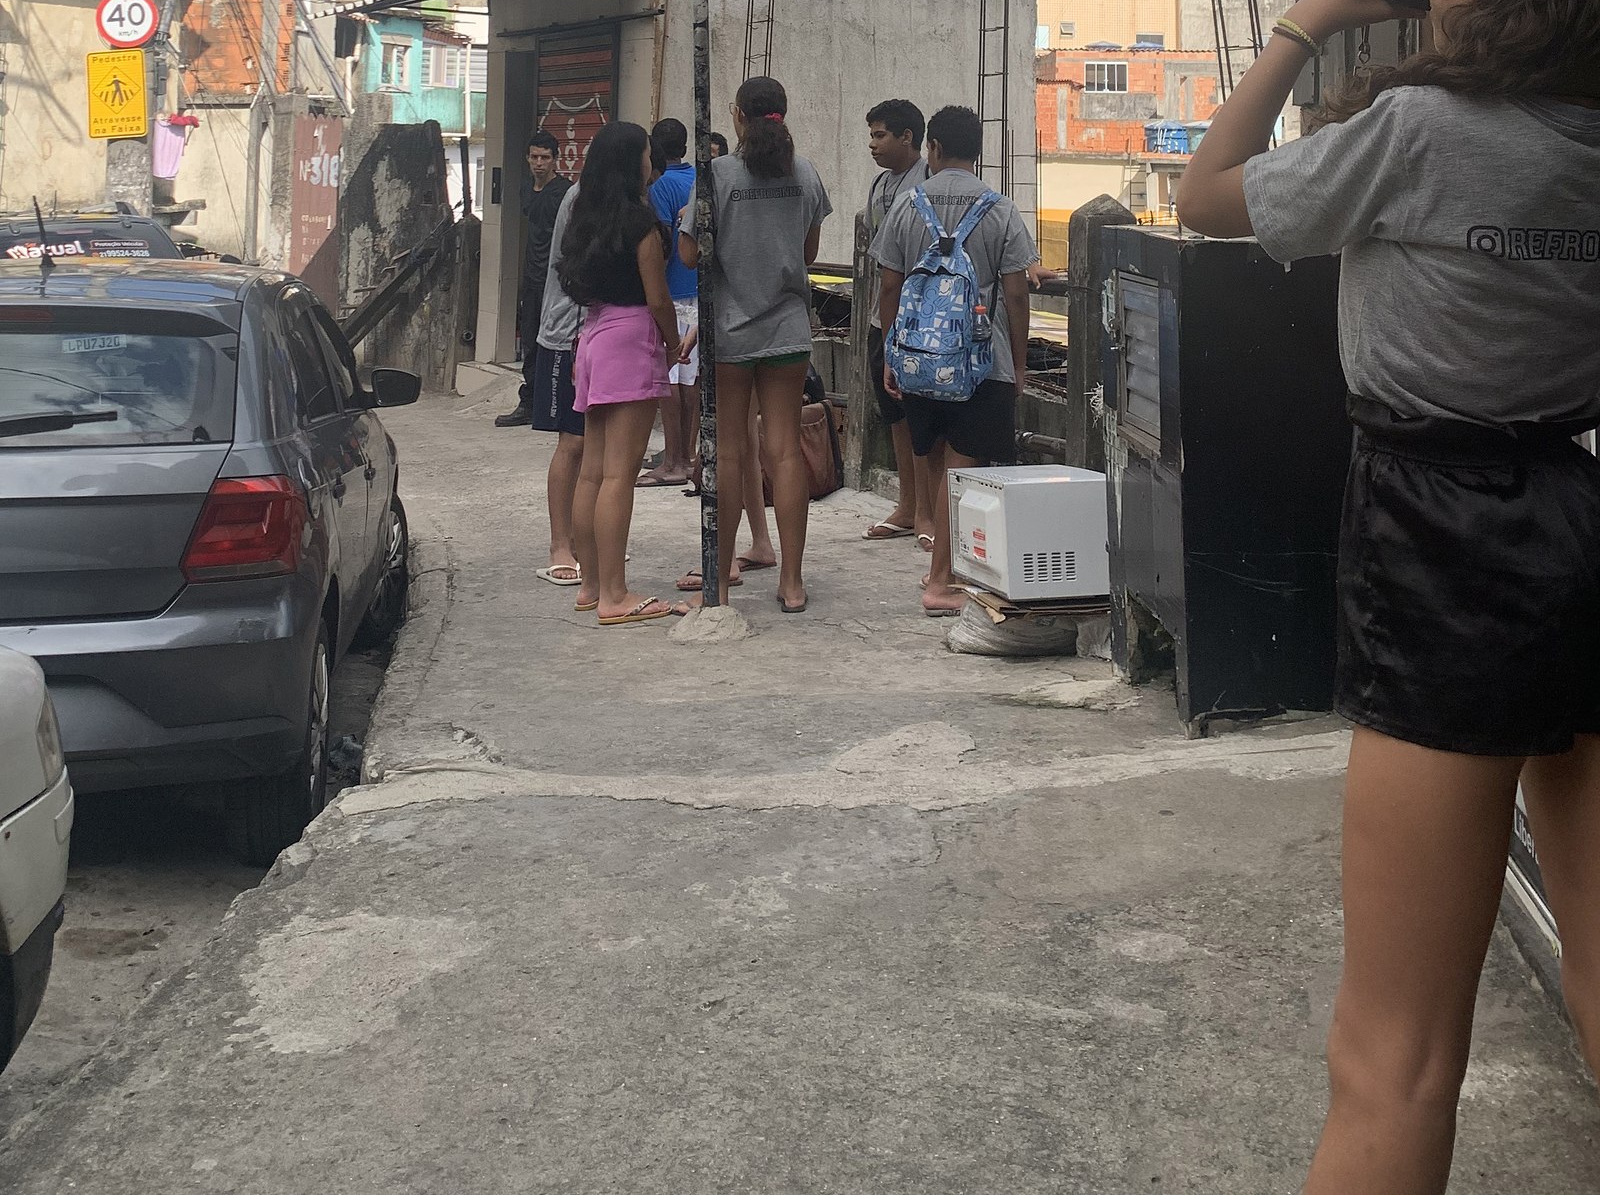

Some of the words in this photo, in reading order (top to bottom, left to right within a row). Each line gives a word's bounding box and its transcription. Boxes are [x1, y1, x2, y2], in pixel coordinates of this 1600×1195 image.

[106, 2, 145, 28] 40
[92, 54, 137, 64] Pedestre
[93, 116, 142, 124] Atravesse
[111, 124, 141, 133] Faixa
